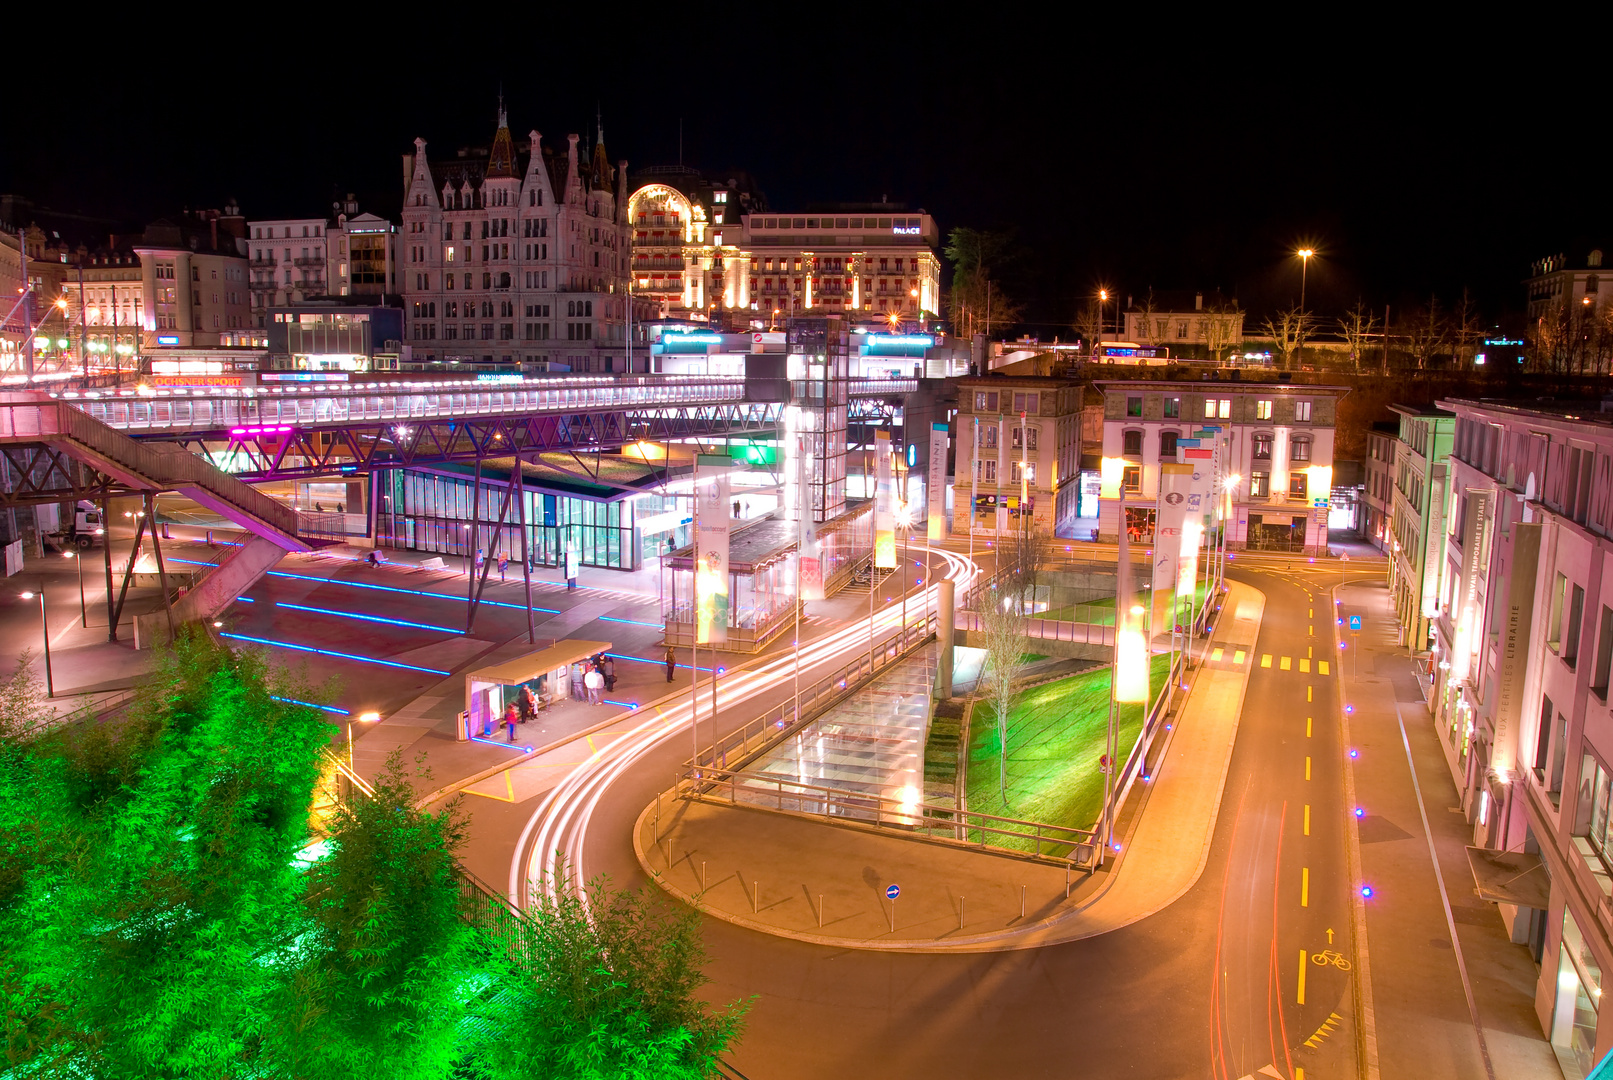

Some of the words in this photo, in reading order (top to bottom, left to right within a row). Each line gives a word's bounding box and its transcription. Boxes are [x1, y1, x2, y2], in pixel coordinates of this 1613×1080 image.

[893, 227, 920, 235] PALACE
[155, 377, 204, 386] OCHSNER
[207, 377, 242, 386] SPORT
[1432, 490, 1441, 504] bar
[1477, 499, 1486, 521] STABLE
[1431, 512, 1440, 534] resto
[1476, 522, 1483, 530] ET
[1472, 532, 1482, 572] TEMPORAIRE
[1468, 574, 1477, 601] TRAVAIL
[1507, 605, 1520, 659] LIBRAIRIE
[1501, 664, 1513, 712] FERTILES
[1498, 717, 1508, 743] YEUX
